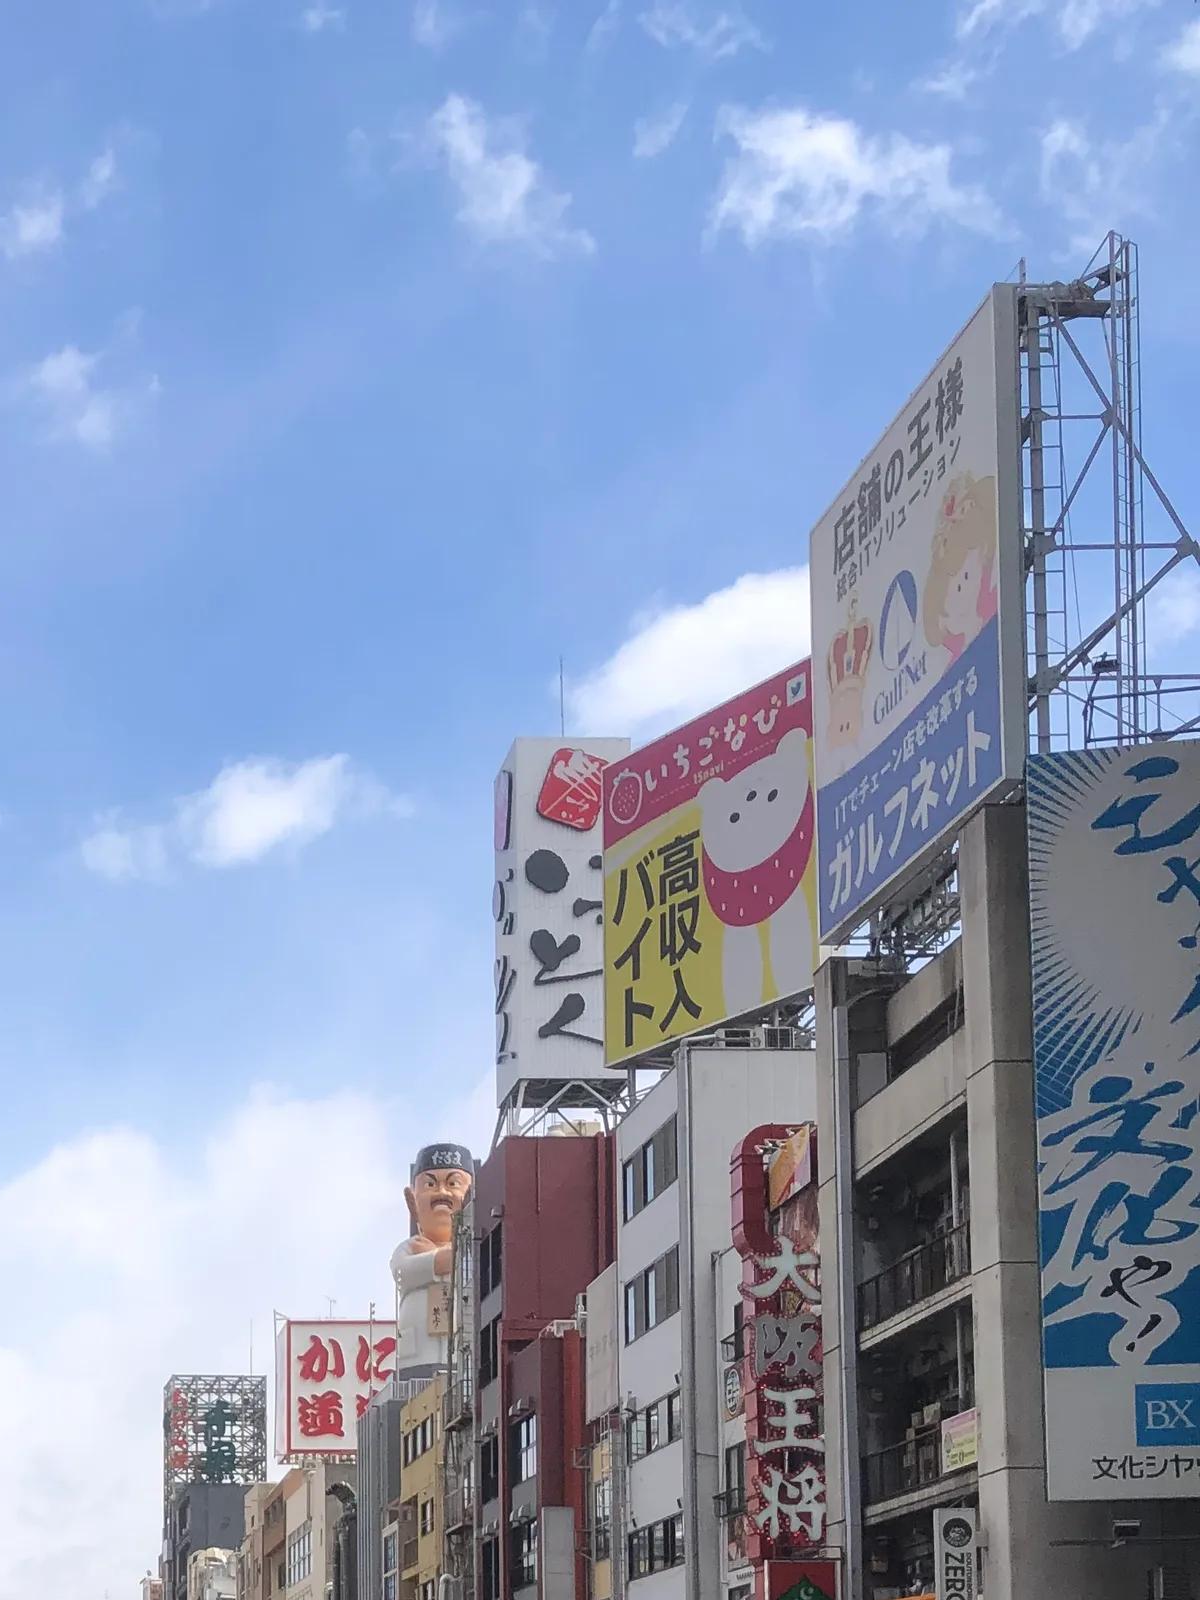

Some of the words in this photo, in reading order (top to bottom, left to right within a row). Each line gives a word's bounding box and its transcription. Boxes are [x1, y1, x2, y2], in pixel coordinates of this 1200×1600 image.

[832, 356, 964, 577] 店舗の王様
[645, 694, 783, 793] いちごなび
[827, 709, 992, 914] ガルフネット
[611, 849, 656, 1049] バイト
[656, 829, 703, 1034] 高収入
[296, 1334, 396, 1383] かに
[742, 1234, 828, 1543] 大阪王将
[1144, 1399, 1196, 1431] BX
